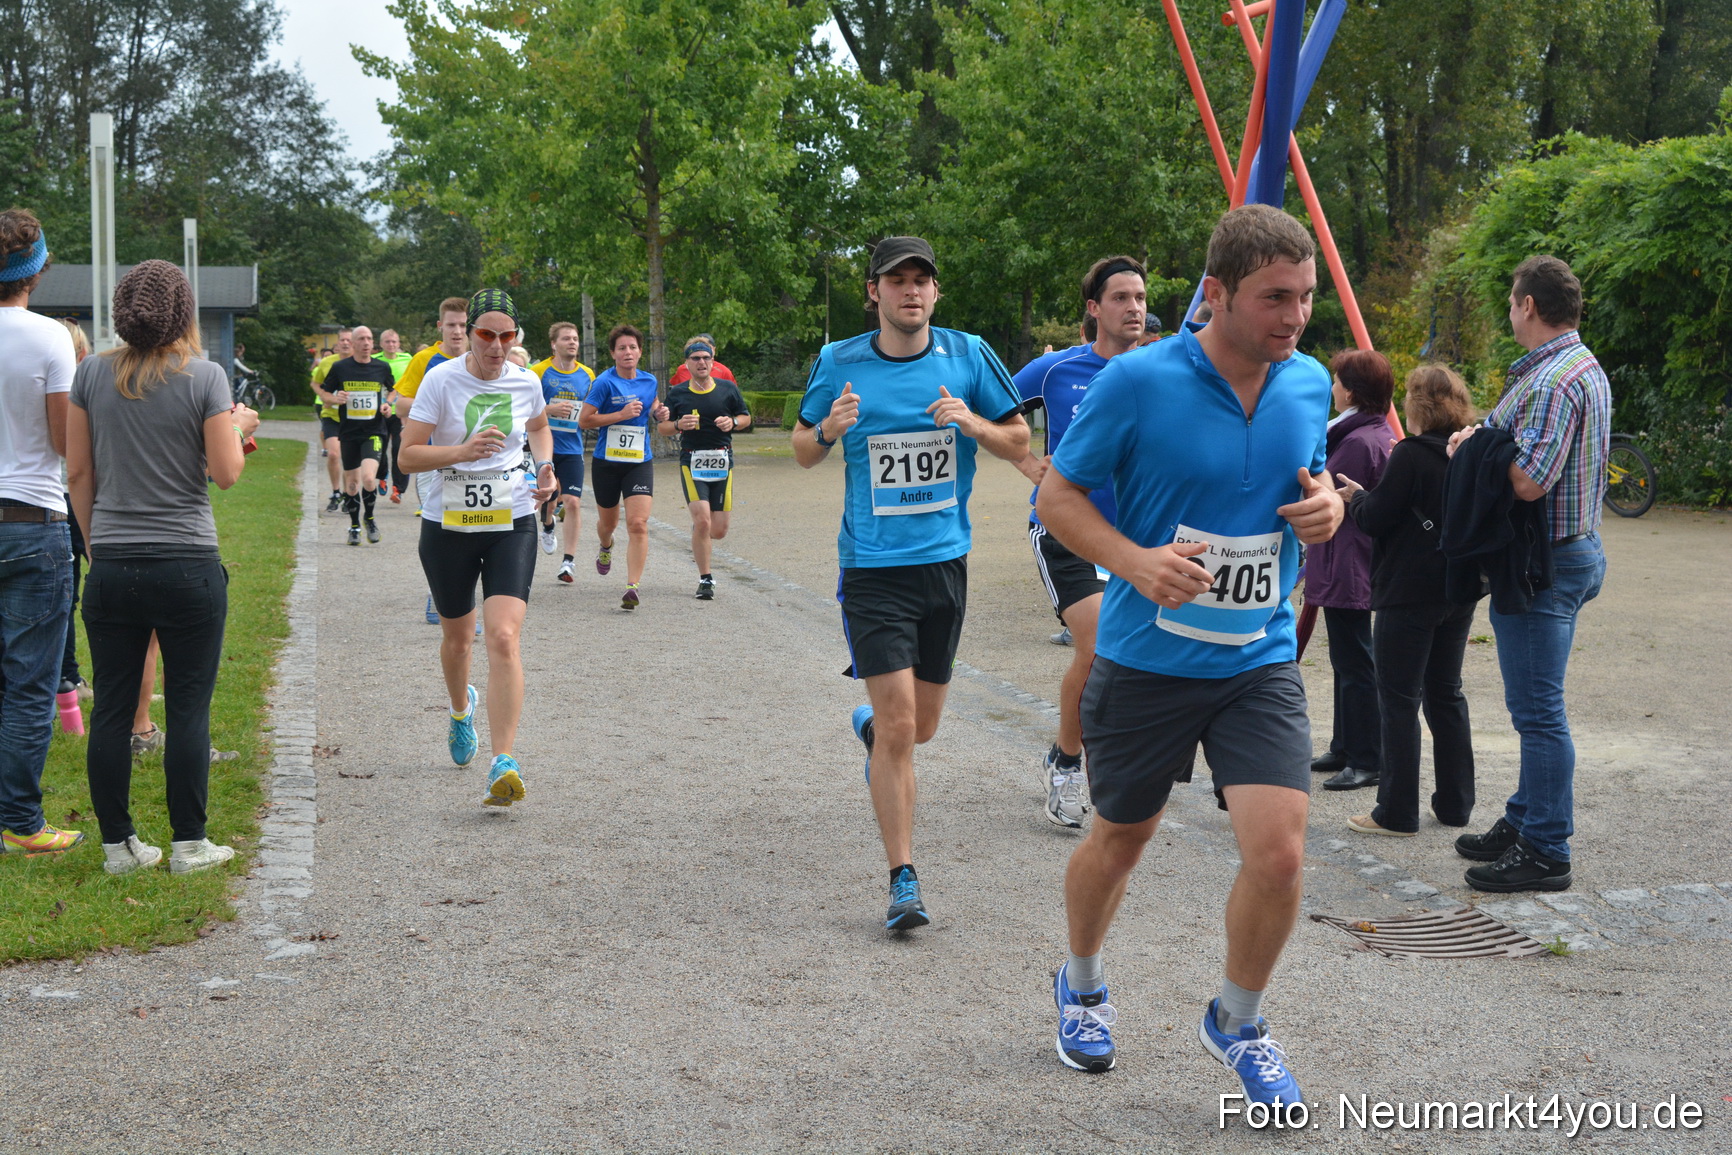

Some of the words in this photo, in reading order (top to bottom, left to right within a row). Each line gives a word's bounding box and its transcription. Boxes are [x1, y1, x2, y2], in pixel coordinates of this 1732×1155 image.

[352, 398, 372, 409] 615
[619, 434, 634, 448] 97
[870, 442, 899, 450] PARTL
[901, 439, 942, 449] Neumarkt
[695, 458, 726, 469] 2429
[879, 449, 949, 484] 2192
[464, 484, 493, 508] 53
[900, 491, 933, 503] Andre
[462, 514, 493, 523] Bettina
[1220, 547, 1268, 558] Neumarkt
